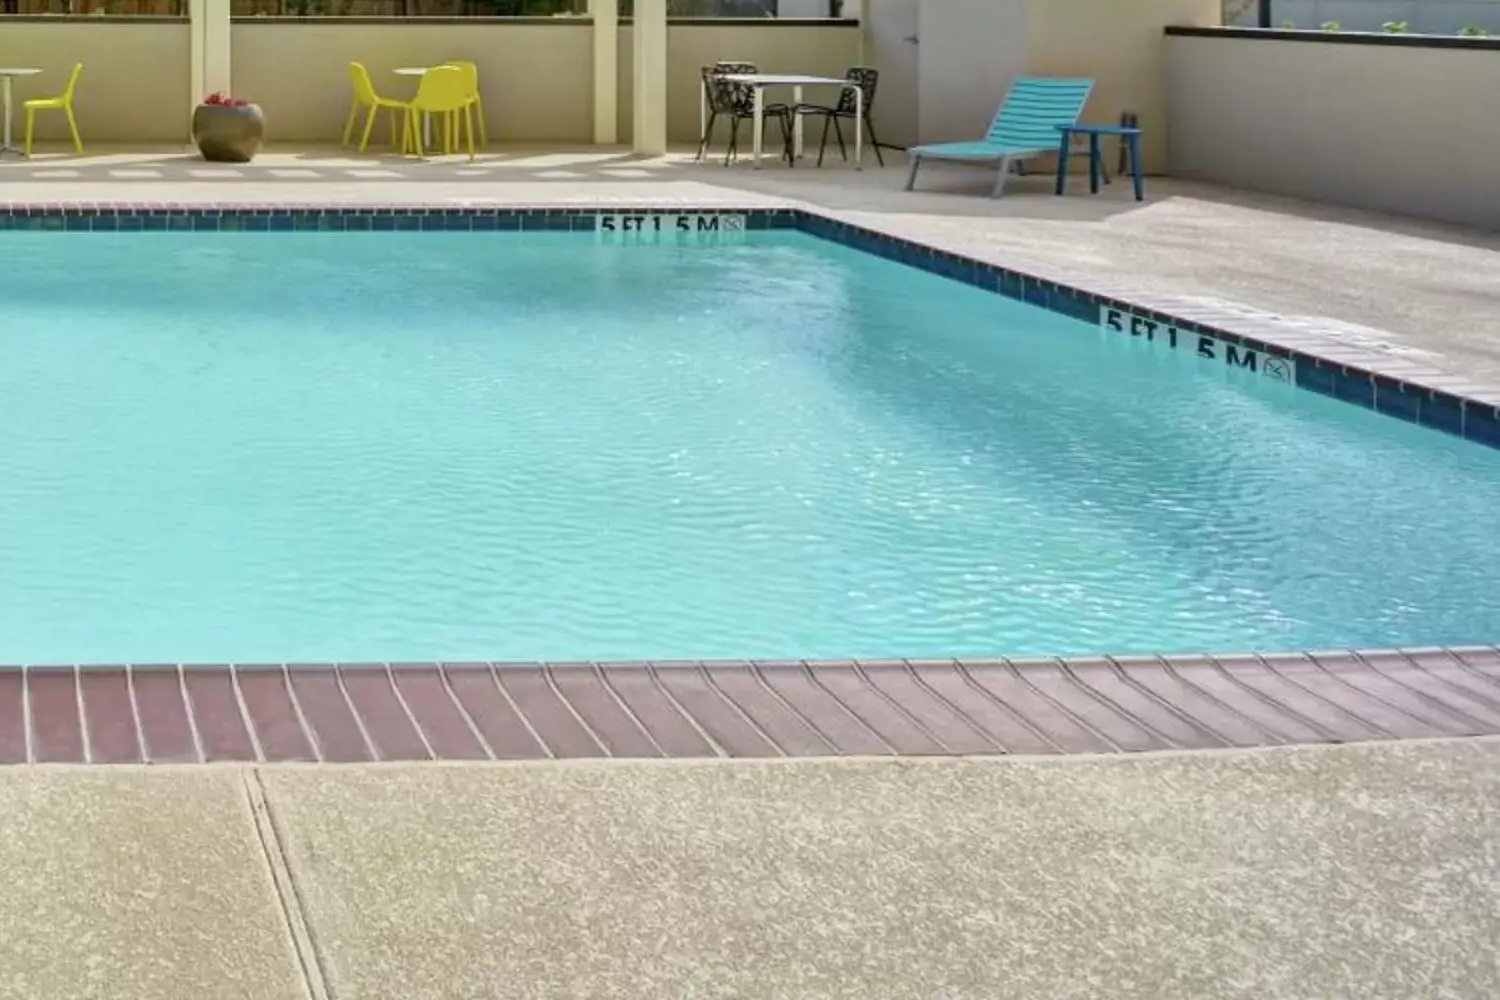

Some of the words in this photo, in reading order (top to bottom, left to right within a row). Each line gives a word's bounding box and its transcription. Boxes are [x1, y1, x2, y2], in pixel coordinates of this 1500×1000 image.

[602, 216, 616, 231] 5
[676, 216, 690, 231] 5
[697, 216, 719, 231] M
[1107, 310, 1122, 332] 5
[1226, 345, 1257, 373] M
